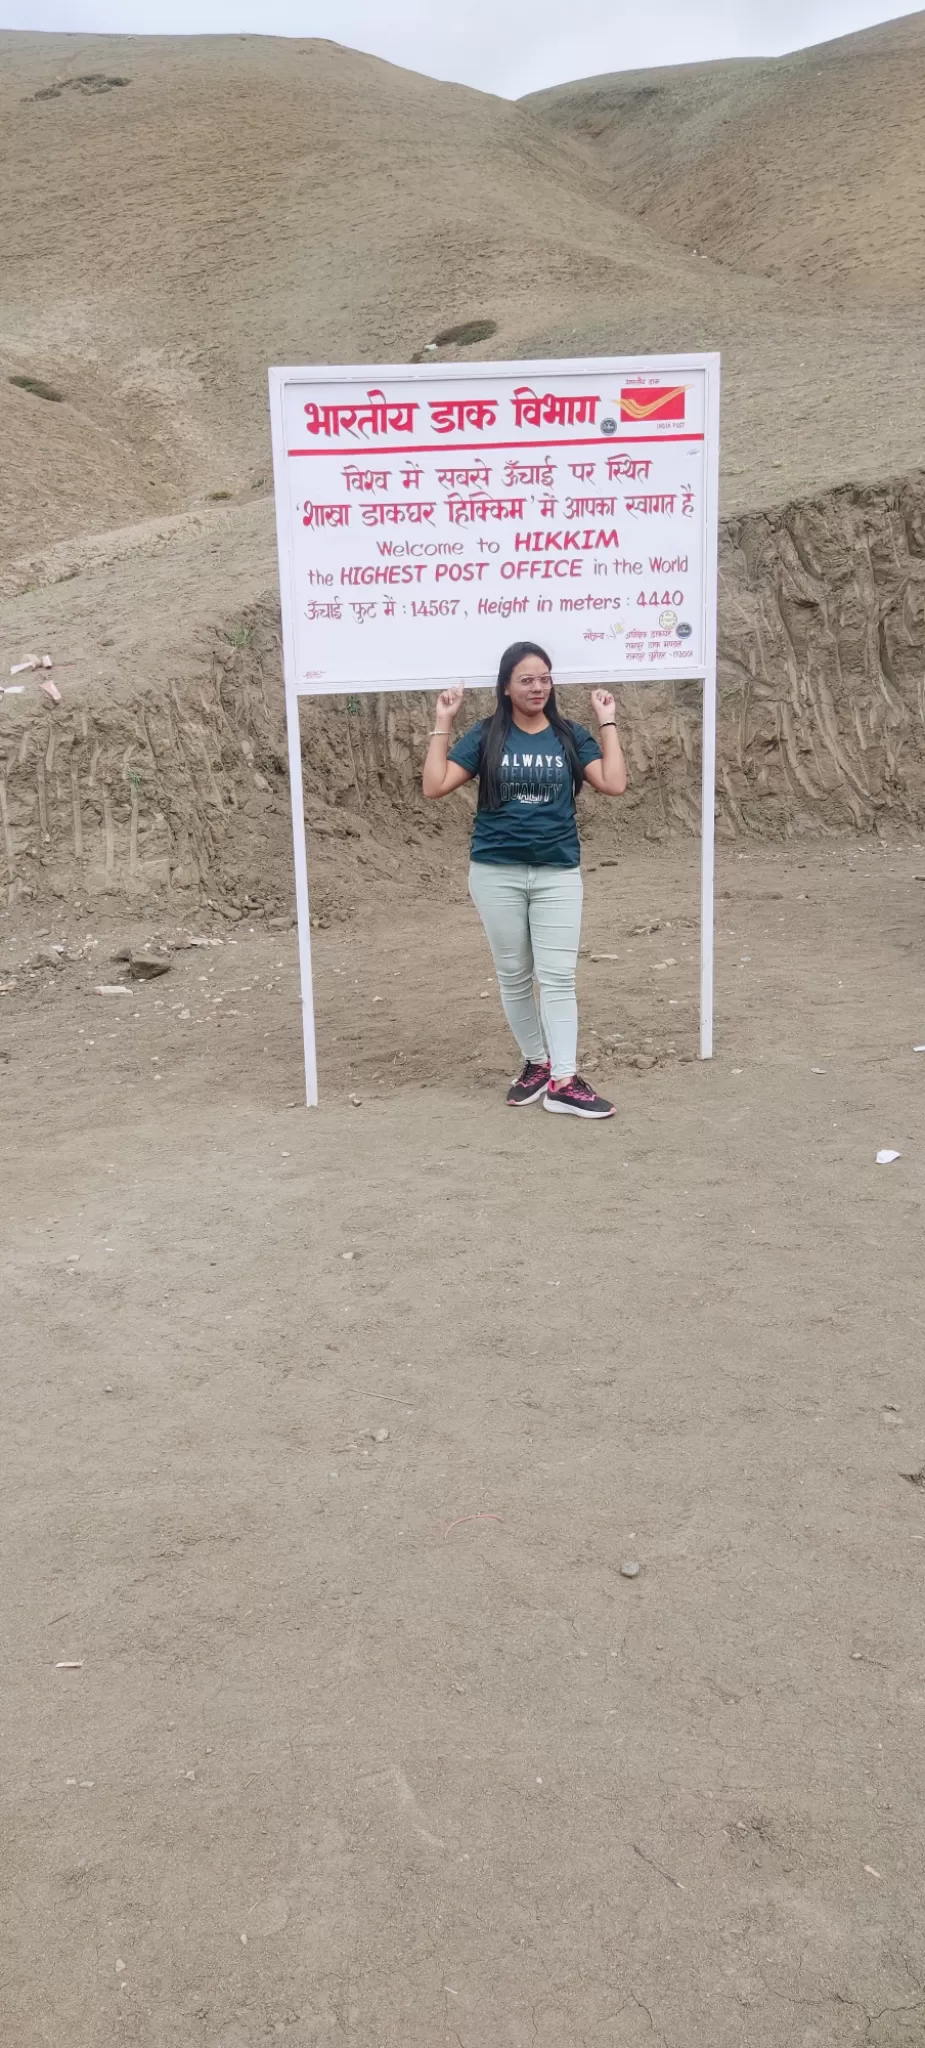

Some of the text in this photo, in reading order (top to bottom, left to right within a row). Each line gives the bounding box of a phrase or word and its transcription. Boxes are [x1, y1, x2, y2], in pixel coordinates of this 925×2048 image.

[304, 389, 419, 439] भारतीय
[429, 399, 498, 434] डाक
[511, 386, 600, 427] विभाग
[342, 454, 653, 495] विश्व में सबसे ऊँचाई पर स्थित
[361, 502, 436, 528] डाकघर
[538, 494, 559, 519] में
[563, 496, 617, 518] आपका
[624, 493, 677, 515] स्वागत
[680, 485, 696, 519] है
[376, 530, 619, 558] Welcome to HIKKIM
[307, 556, 688, 587] the HIGHEST POST OFFICE in the World
[304, 595, 343, 621] ऊँचाई
[348, 601, 377, 624] फुट
[382, 595, 397, 619] में
[478, 596, 529, 617] Height
[537, 595, 553, 612] in
[560, 595, 621, 610] meters
[636, 590, 684, 607] 4440
[500, 768, 563, 782] DELIVER
[501, 754, 563, 767] ALWAYS
[500, 782, 563, 801] QUALITY
